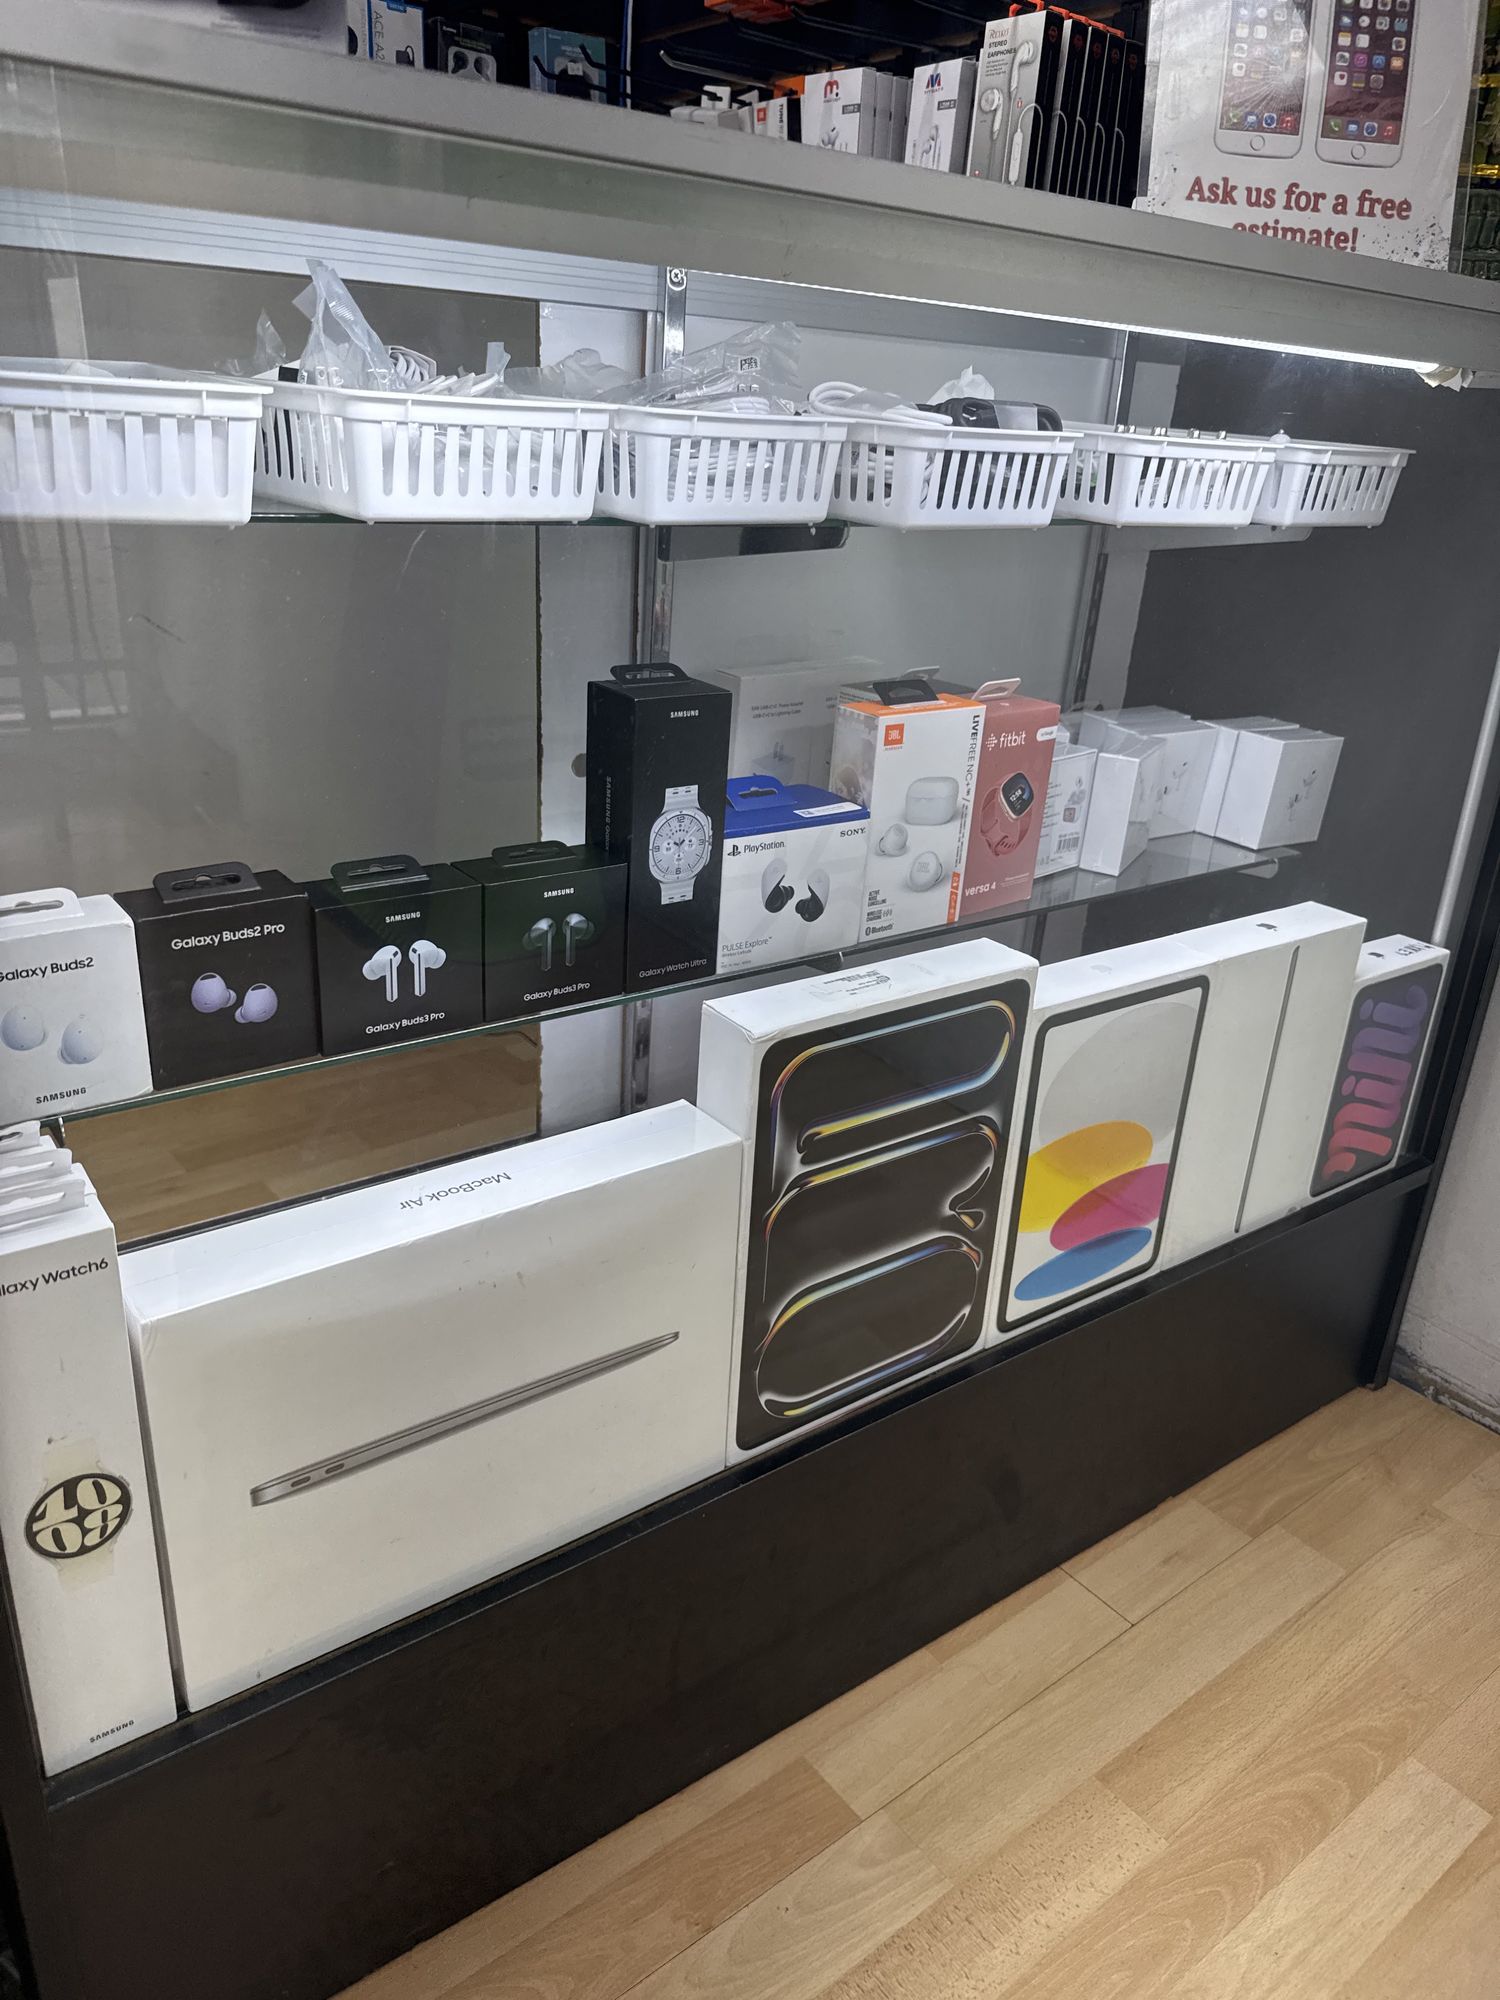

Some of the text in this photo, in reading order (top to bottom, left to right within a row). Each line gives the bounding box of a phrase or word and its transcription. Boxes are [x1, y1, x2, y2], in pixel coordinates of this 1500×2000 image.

[374, 11, 384, 39] ACE
[987, 47, 1017, 58] EARPHONES
[988, 40, 1007, 49] STEREO
[1186, 176, 1412, 220] Ask us for a free
[670, 710, 700, 718] SAMSUNG
[888, 729, 901, 741] JBL
[1000, 729, 1026, 748] fitbit
[840, 827, 866, 838] SONY
[743, 841, 785, 854] PlayStation
[543, 887, 575, 898] SAMSUNG
[965, 881, 996, 897] versa 4
[385, 911, 421, 923] SAMSUNG
[171, 922, 285, 950] Galaxy Buds2 Pro
[722, 943, 744, 952] PULSE
[50, 956, 94, 974] Buds2
[639, 959, 707, 977] Galaxy Watch Ultra
[523, 982, 590, 1001] Galaxy Buds3 Pro
[365, 1011, 445, 1034] Galaxy Buds3 Pro
[36, 1087, 87, 1104] SAMSUNG
[400, 1172, 512, 1210] MacBook Air
[41, 1258, 109, 1285] Watch6
[89, 1719, 135, 1743] SAMSUNG
